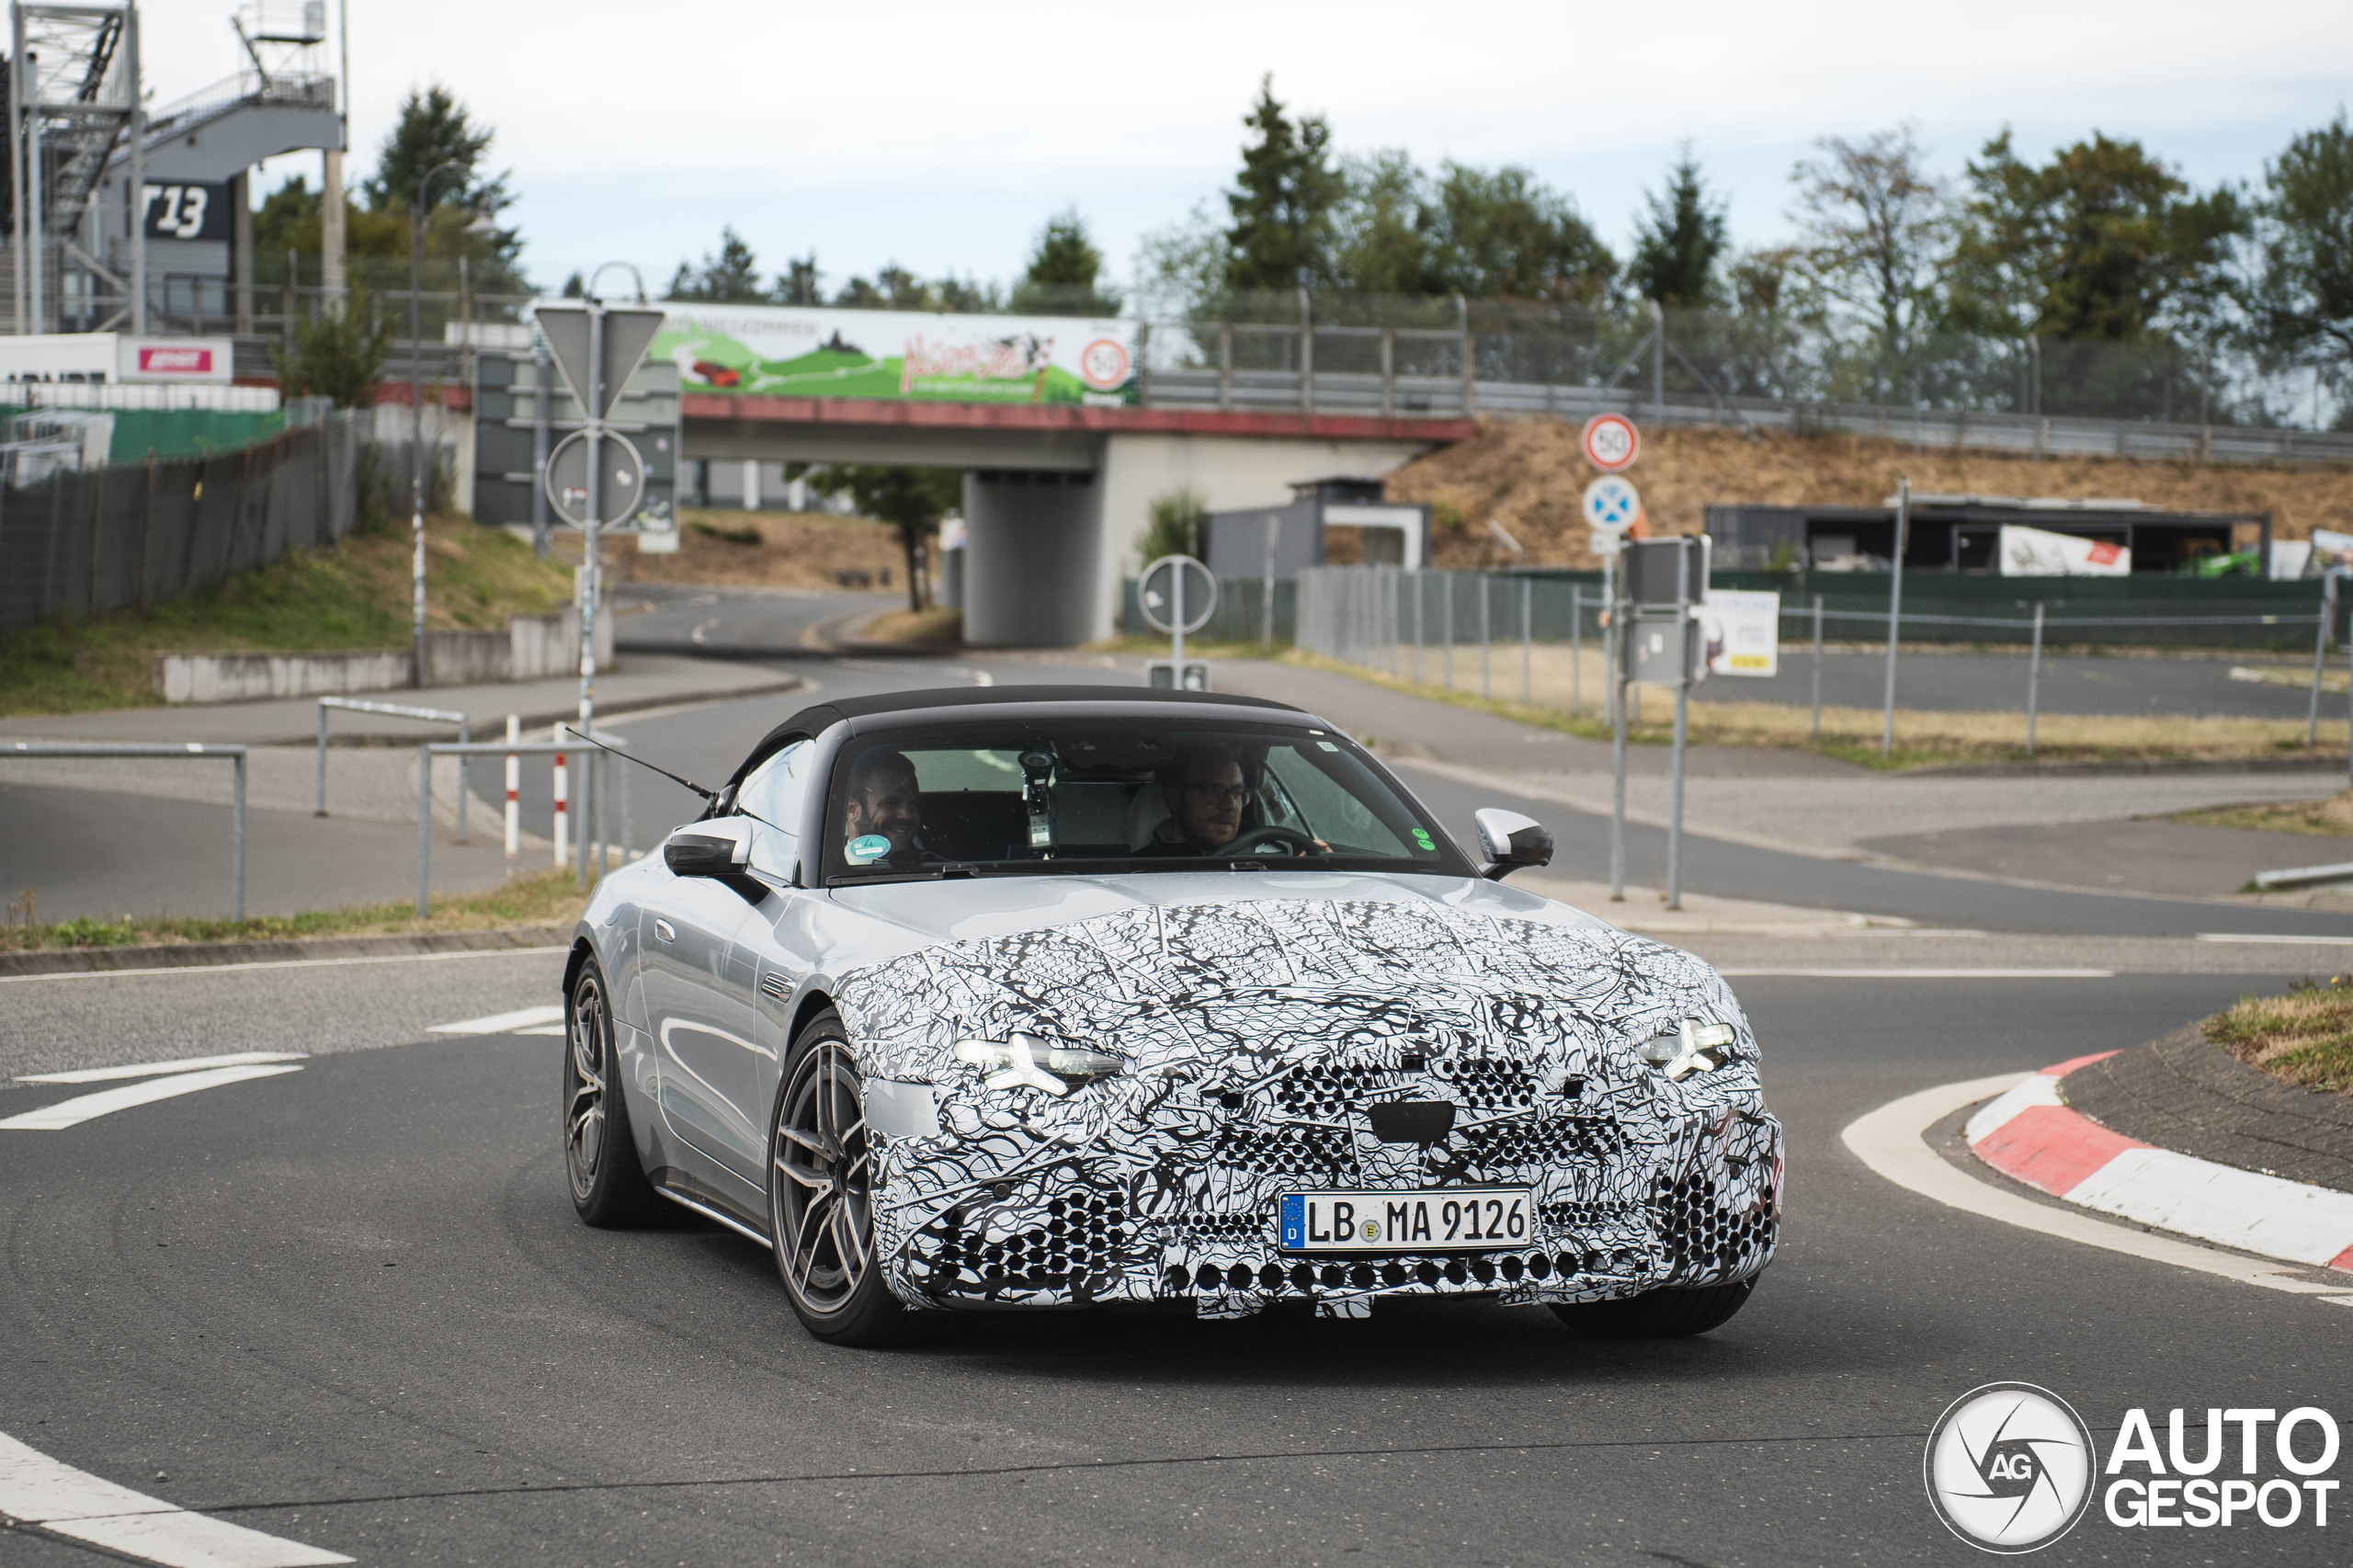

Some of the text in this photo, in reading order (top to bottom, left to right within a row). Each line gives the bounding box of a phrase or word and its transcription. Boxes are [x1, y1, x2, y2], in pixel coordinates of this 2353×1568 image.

[1598, 430, 1625, 453] 50
[864, 837, 874, 847] 4
[1309, 1199, 1525, 1242] LB MA 9126
[1288, 1227, 1297, 1240] D
